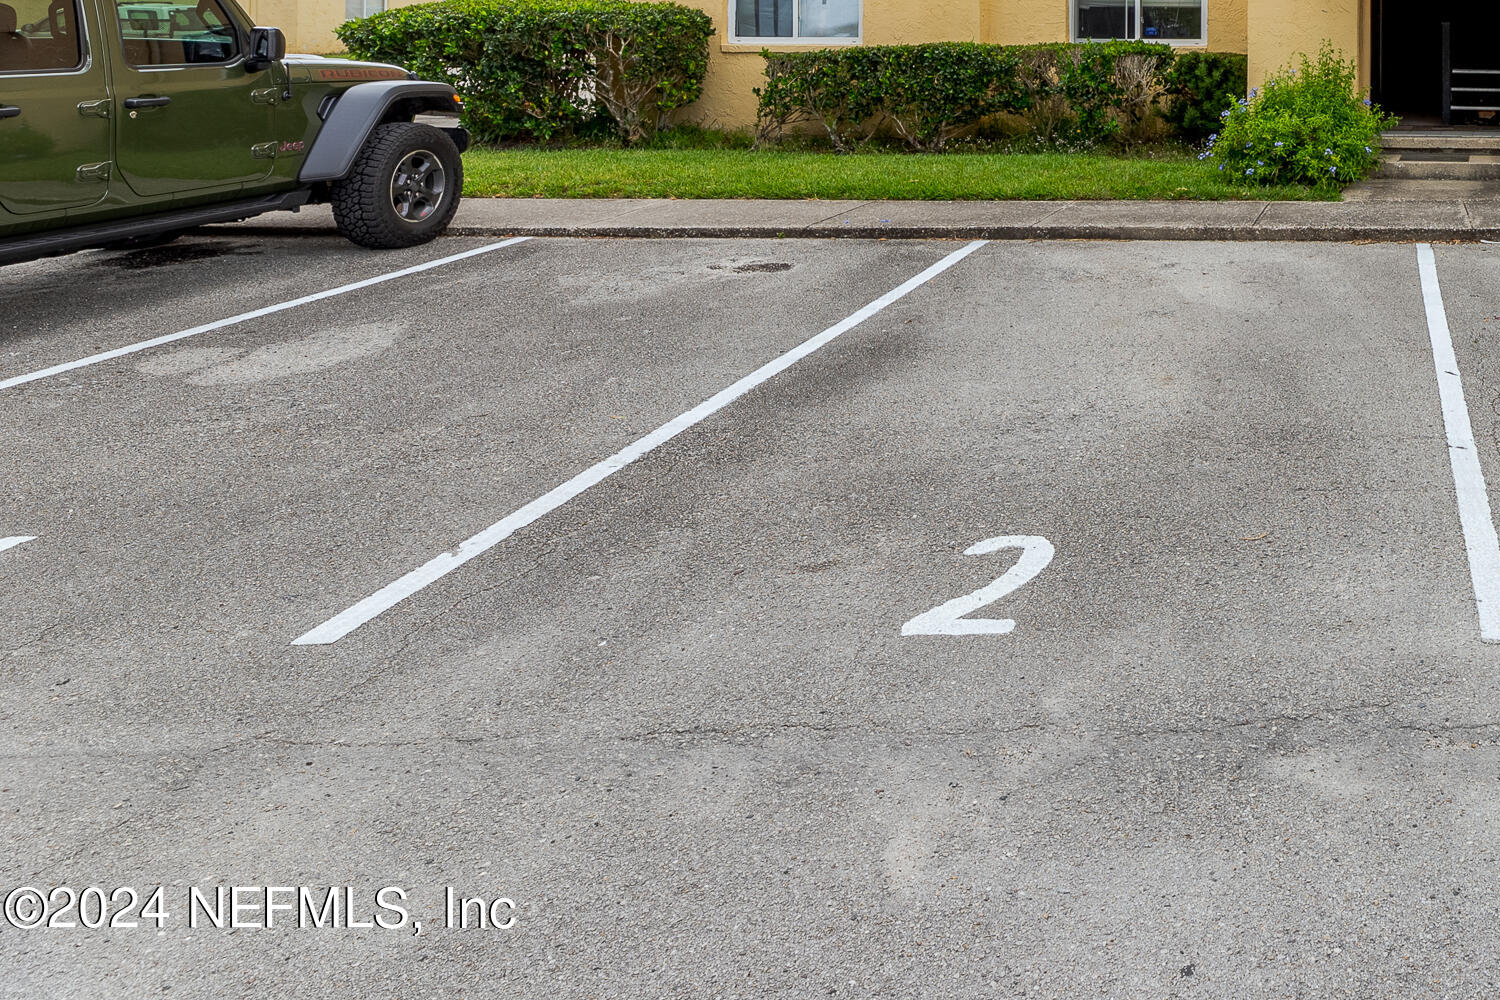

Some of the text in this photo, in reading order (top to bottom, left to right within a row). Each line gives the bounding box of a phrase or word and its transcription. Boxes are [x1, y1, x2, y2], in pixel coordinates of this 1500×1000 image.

[319, 68, 405, 80] RUBICON
[278, 140, 304, 153] Jeep
[901, 535, 1056, 636] 2
